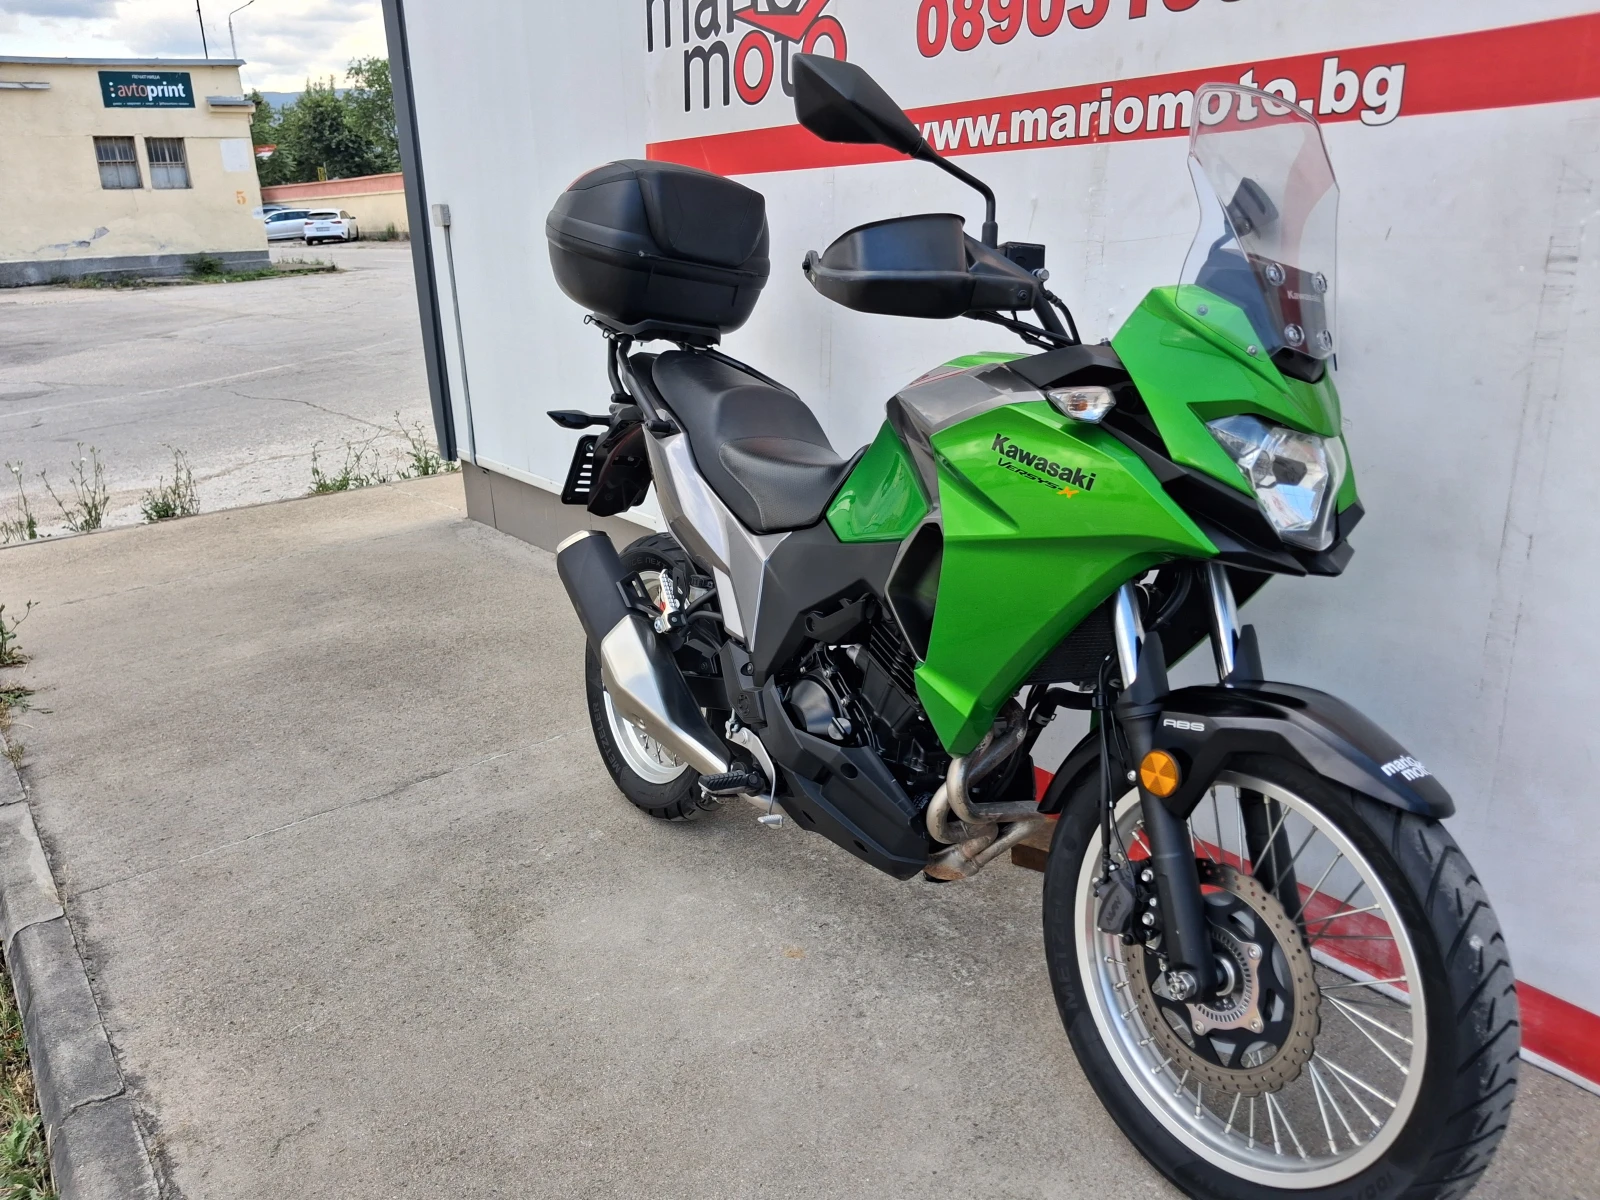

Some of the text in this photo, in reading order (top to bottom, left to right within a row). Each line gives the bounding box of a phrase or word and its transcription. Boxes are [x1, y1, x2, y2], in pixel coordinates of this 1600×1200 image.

[117, 81, 186, 101] avtoprint
[235, 190, 247, 205] 5
[991, 432, 1096, 491] Kawasaki
[1163, 718, 1205, 732] ABS
[592, 701, 622, 774] METZELER
